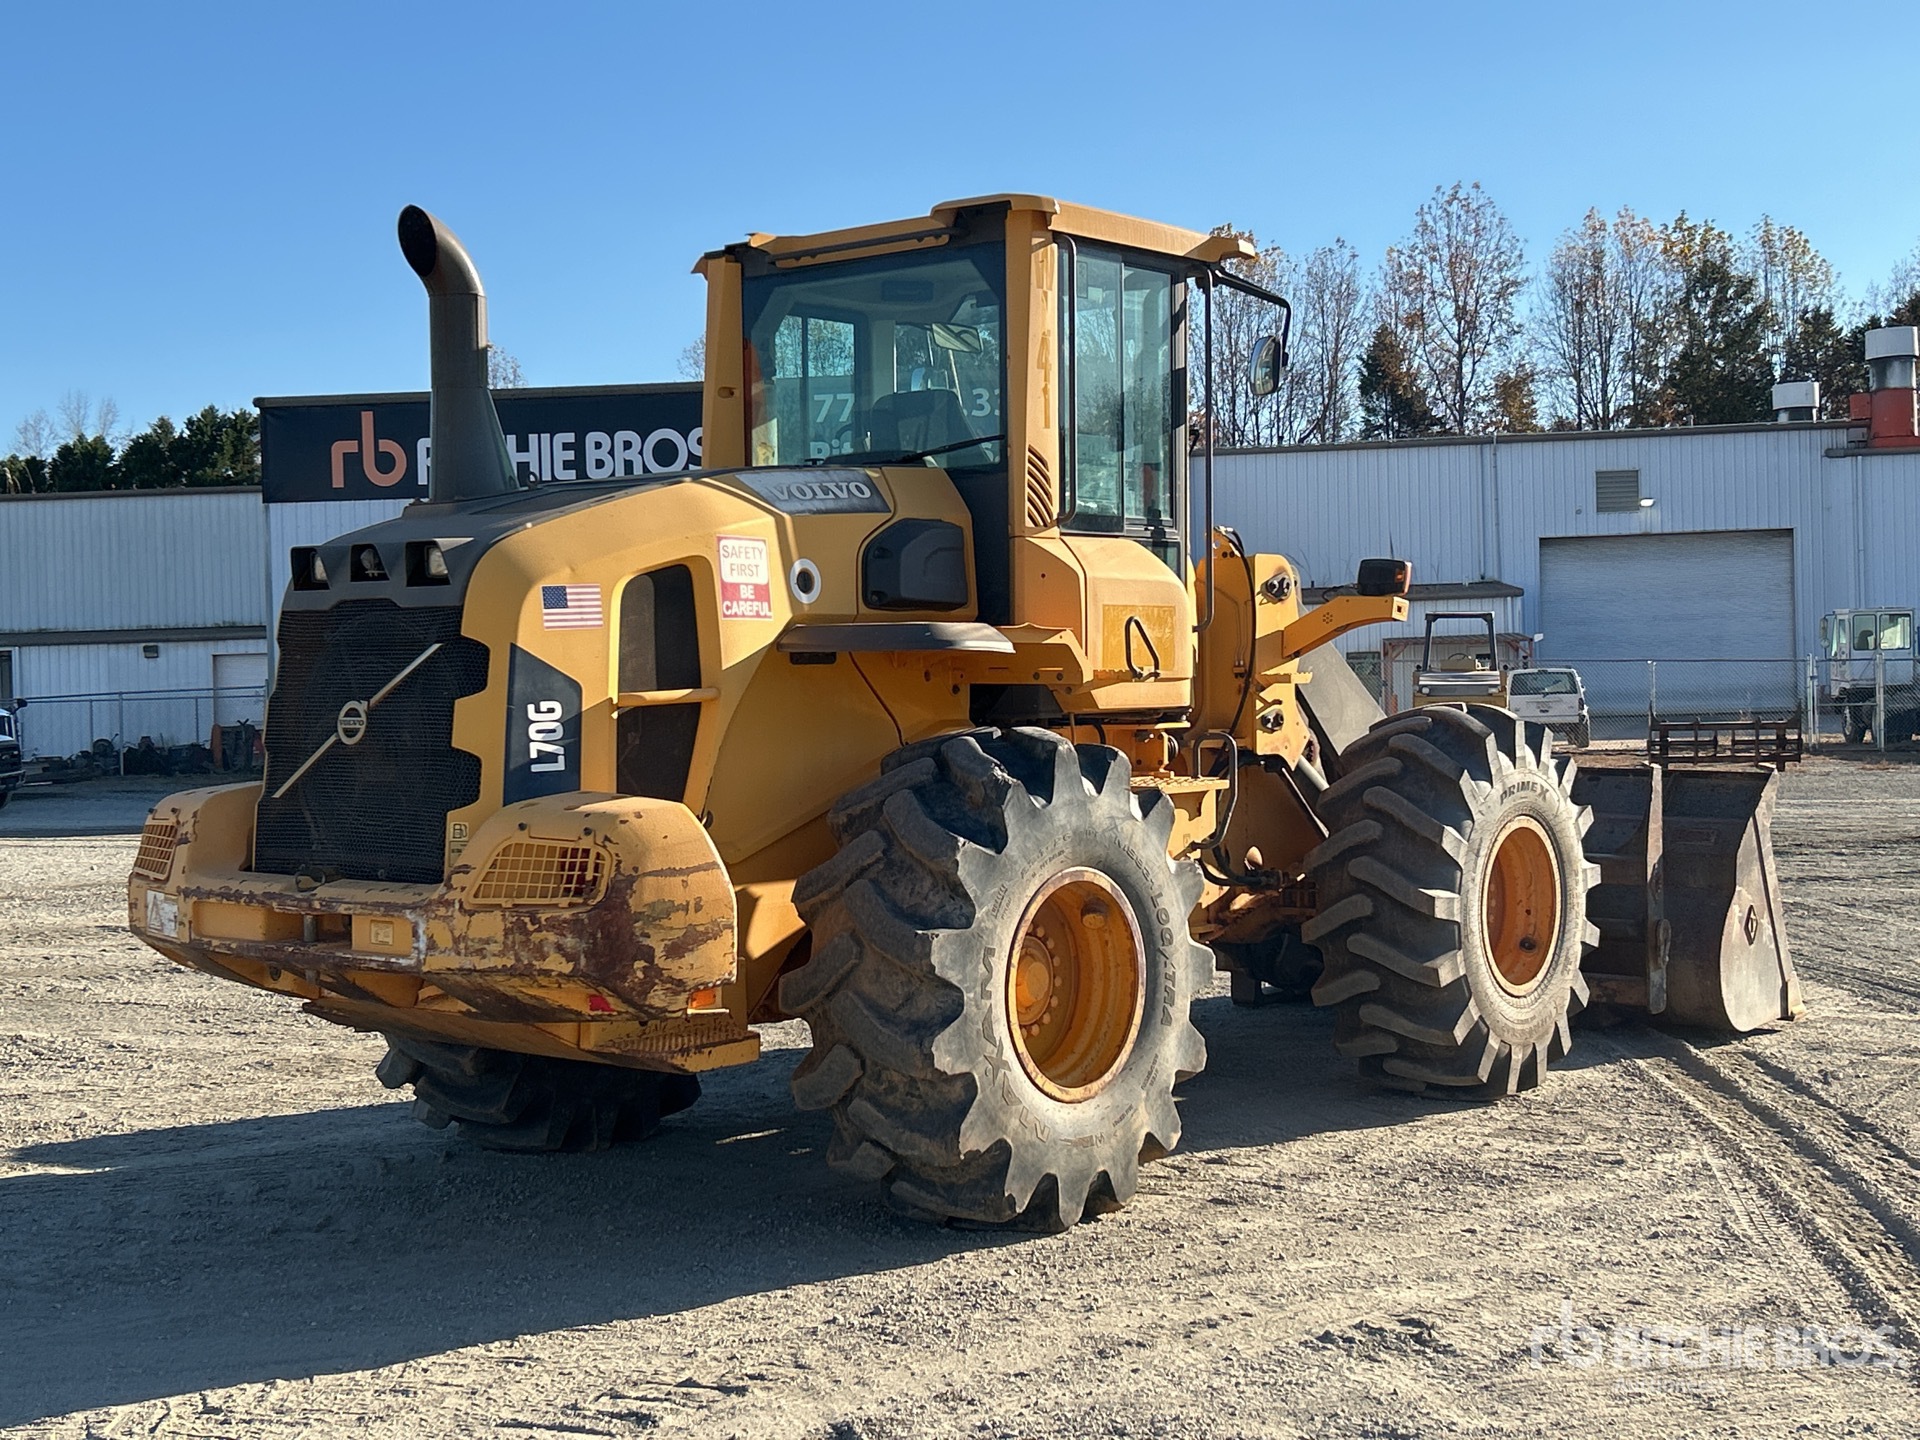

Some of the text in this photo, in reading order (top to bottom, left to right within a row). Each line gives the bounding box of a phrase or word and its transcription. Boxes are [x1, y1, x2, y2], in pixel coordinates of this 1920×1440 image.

[767, 482, 871, 500] VOLVO
[722, 545, 763, 559] SAFETY
[730, 563, 760, 577] FIRST
[740, 584, 755, 599] BE
[723, 600, 773, 616] CAREFUL
[527, 700, 565, 772] L70G
[1500, 781, 1549, 805] PRIMEX
